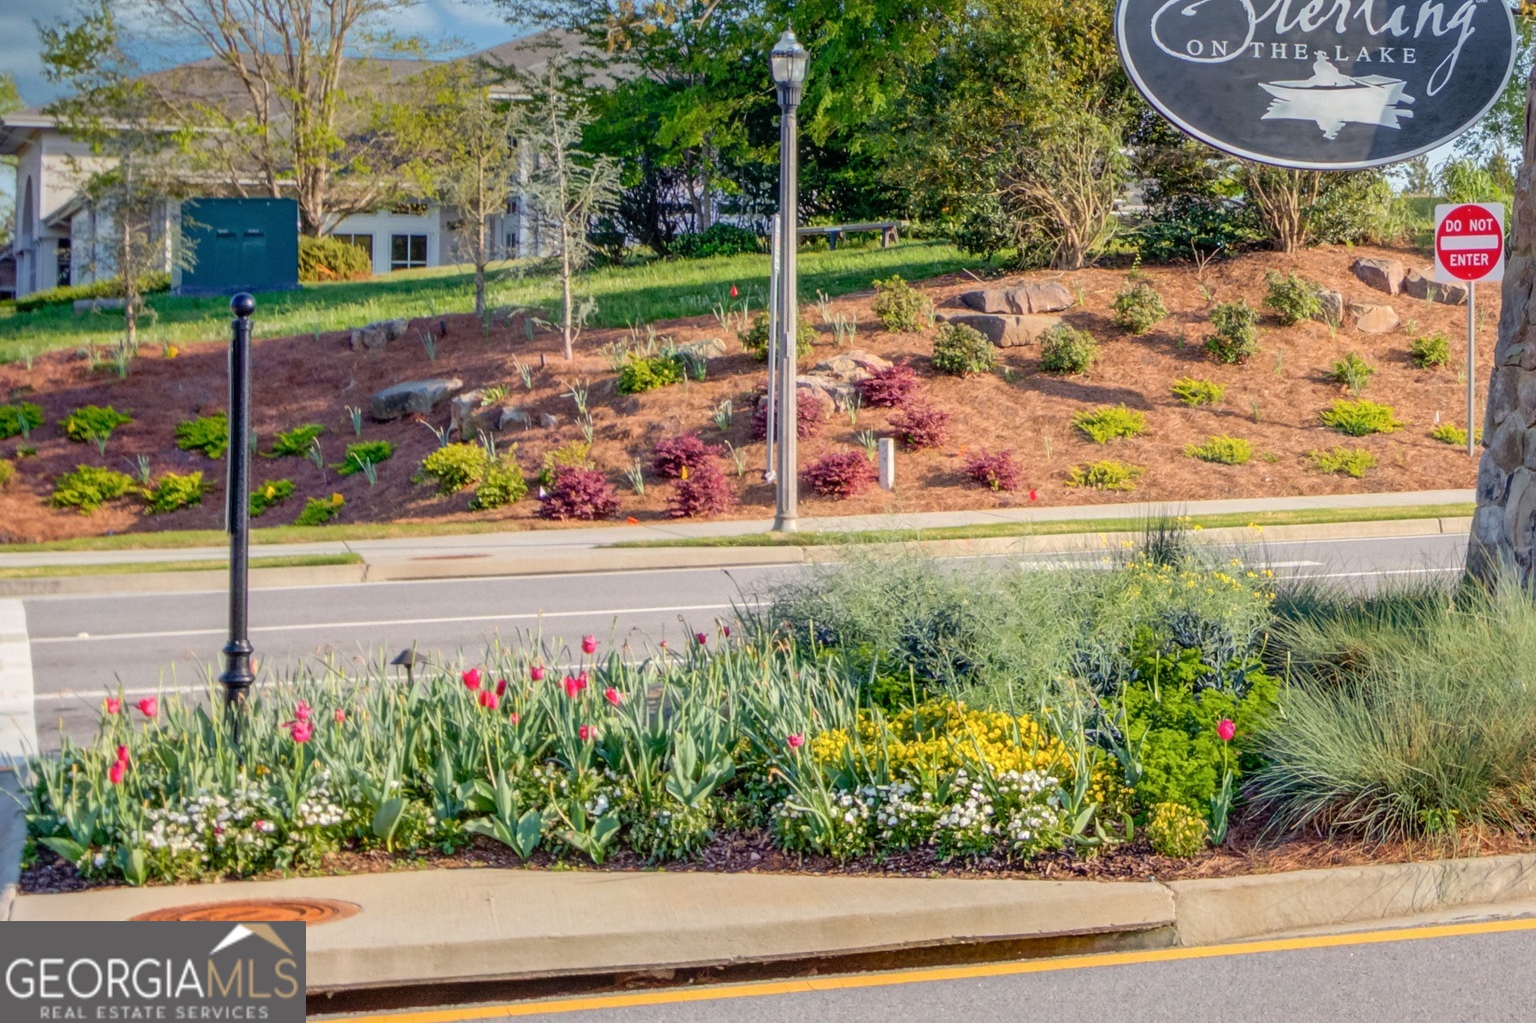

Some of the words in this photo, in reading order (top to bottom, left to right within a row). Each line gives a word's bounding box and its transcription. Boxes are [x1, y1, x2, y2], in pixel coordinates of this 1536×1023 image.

[1186, 39, 1228, 58] ON
[1250, 42, 1308, 60] THE
[1334, 45, 1417, 64] LAKE
[1445, 219, 1462, 232] DO
[1469, 218, 1493, 232] NOT
[1449, 253, 1489, 266] ENTER
